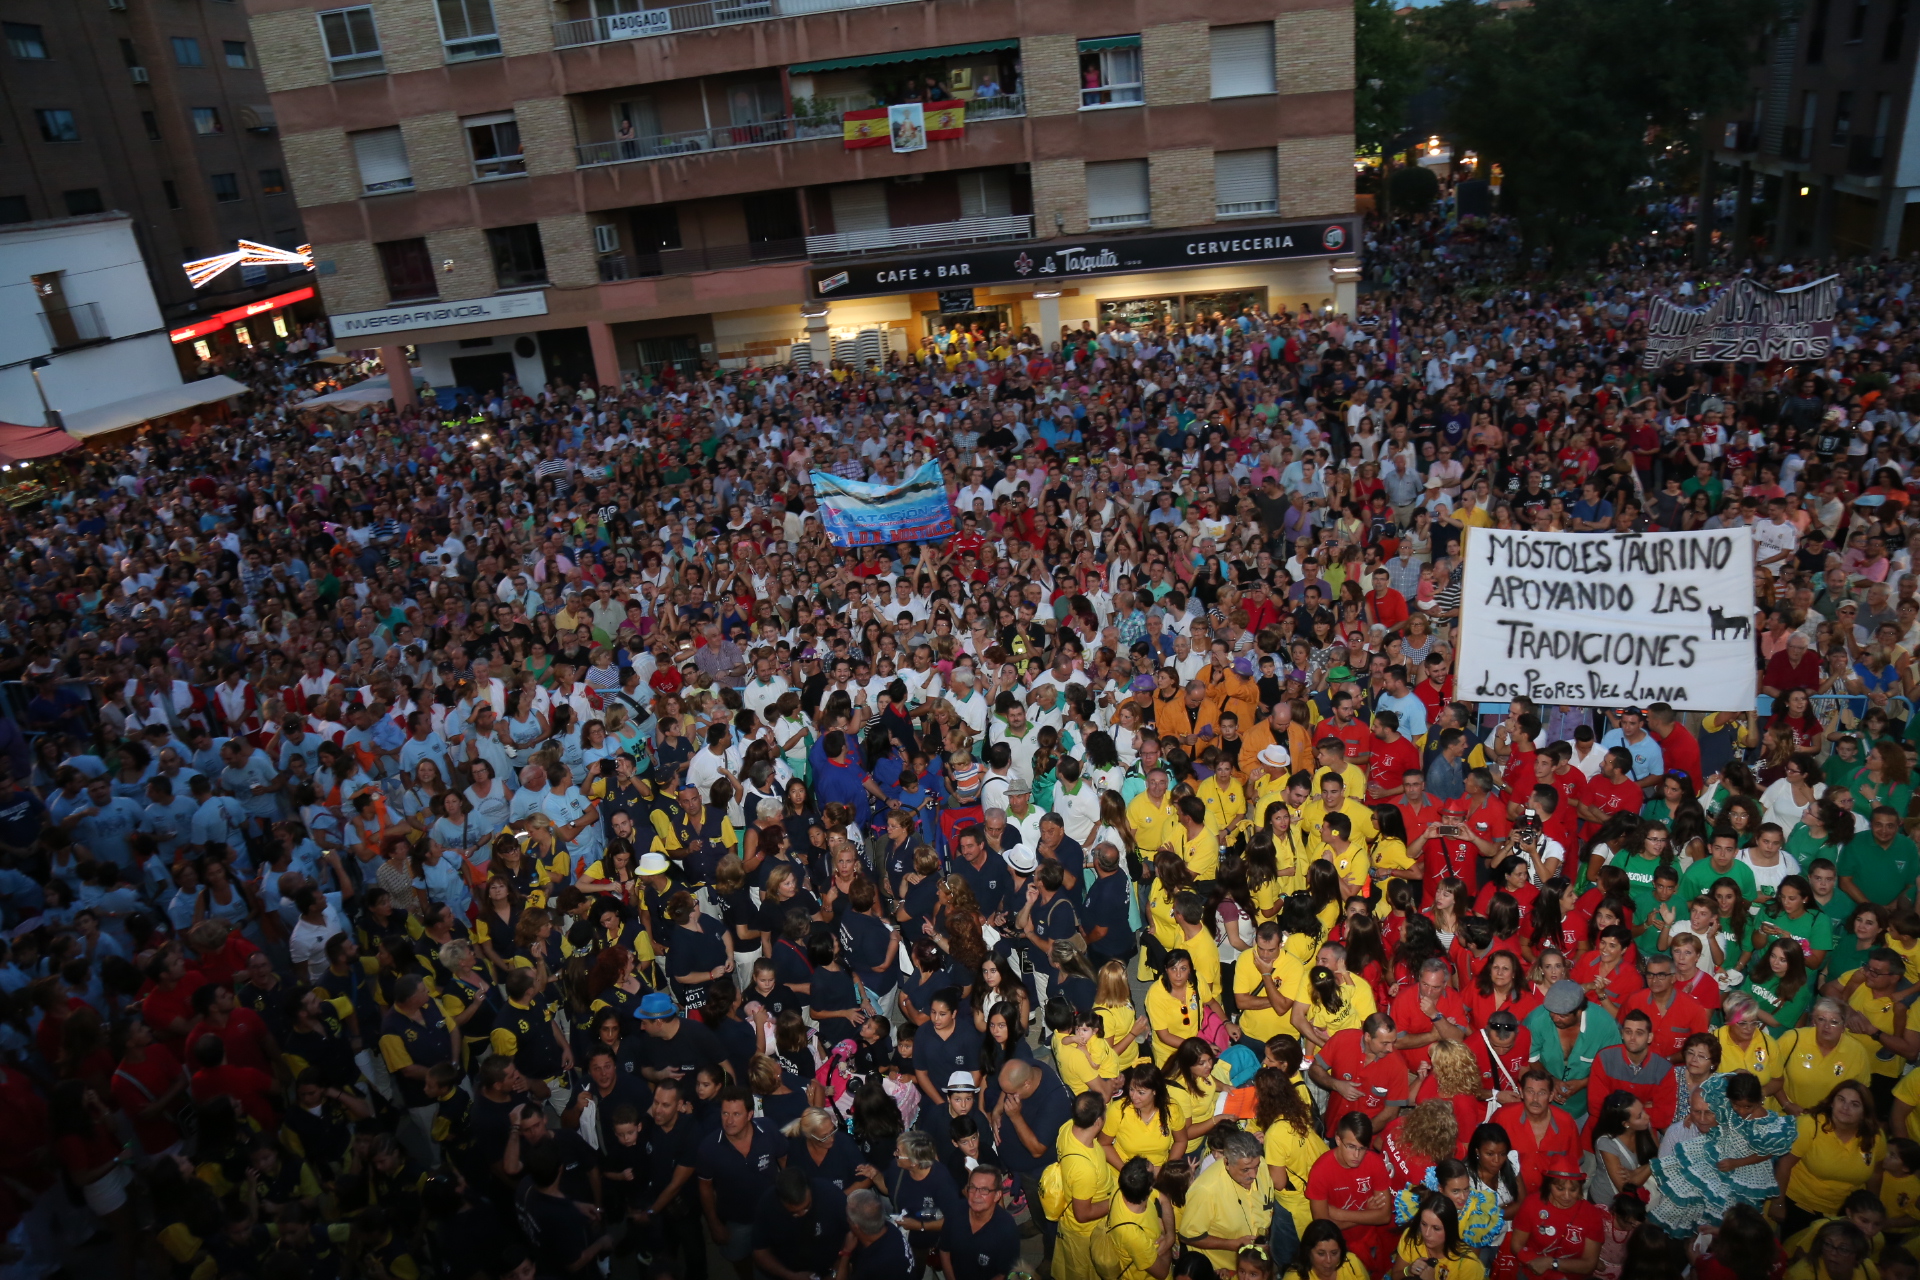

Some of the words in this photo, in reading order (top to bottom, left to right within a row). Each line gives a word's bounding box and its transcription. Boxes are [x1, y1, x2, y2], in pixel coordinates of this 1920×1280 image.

[611, 11, 668, 31] ABOGADO
[1186, 235, 1294, 255] CERVECERIA
[876, 268, 918, 283] CAFE
[937, 263, 971, 278] BAR
[1038, 256, 1057, 273] La
[1055, 247, 1119, 272] Tasquita
[345, 313, 413, 330] INVERSIA
[1642, 336, 1831, 369] EMEZAMOS
[1486, 535, 1612, 573] MÓSTOLES
[1613, 533, 1732, 574] TAURINO
[1485, 575, 1634, 611] APOYANDO
[1651, 583, 1701, 613] LAS
[1497, 620, 1699, 668] TRADICIONES
